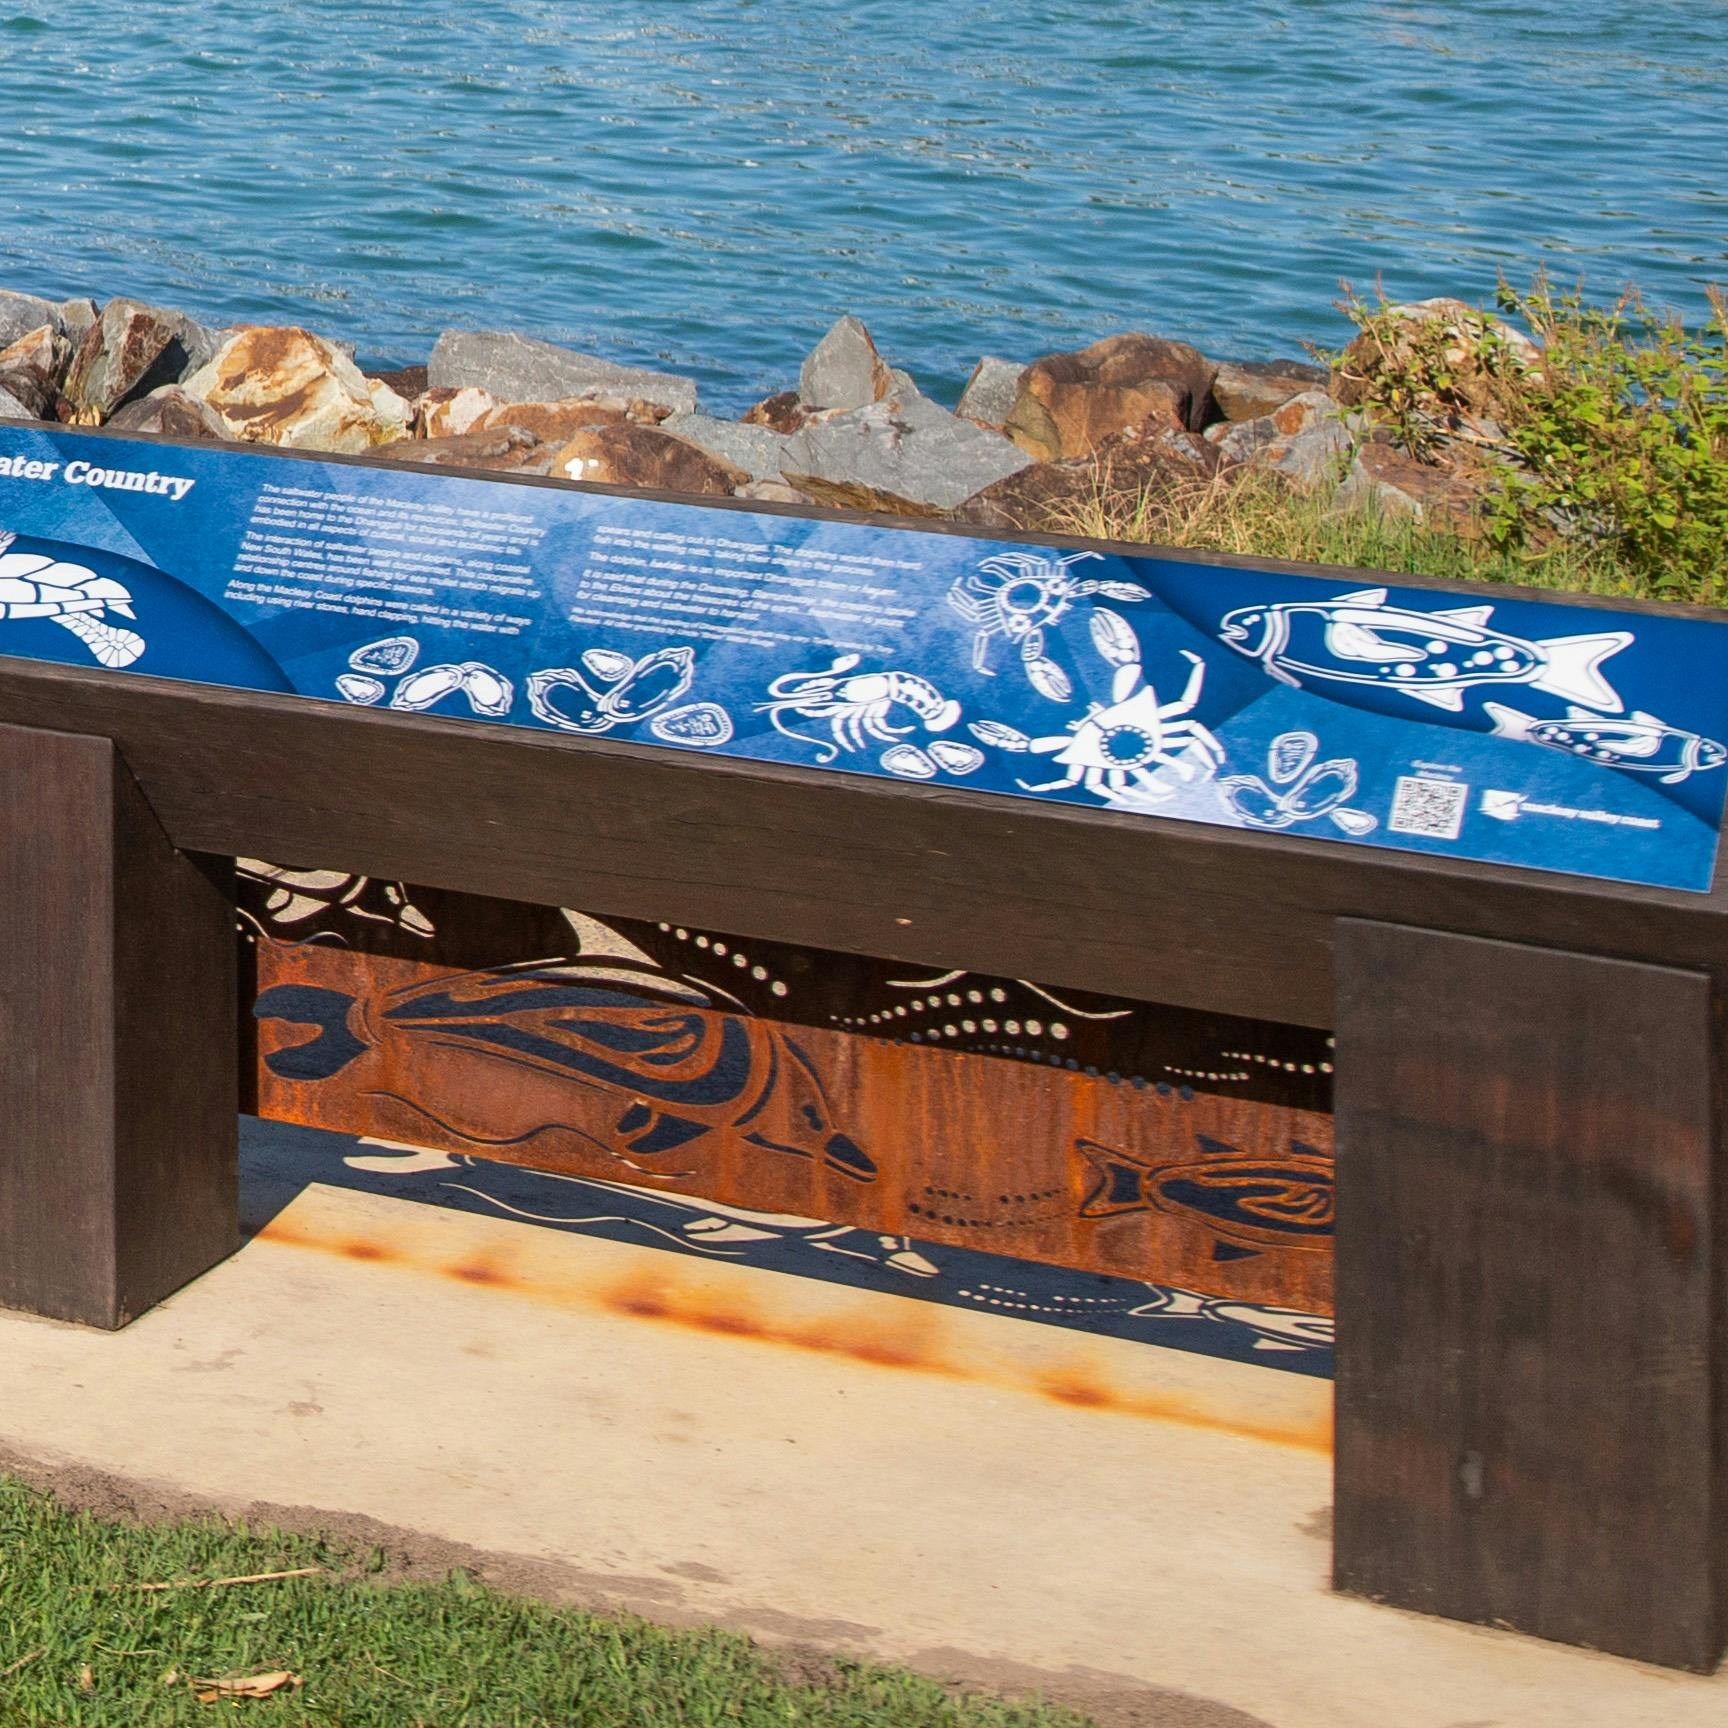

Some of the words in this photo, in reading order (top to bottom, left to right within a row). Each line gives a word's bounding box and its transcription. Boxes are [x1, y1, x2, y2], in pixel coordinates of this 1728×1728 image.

[64, 460, 195, 500] Country
[257, 495, 307, 506] connection
[309, 501, 328, 509] with
[323, 492, 356, 502] people
[272, 507, 297, 516] been
[298, 510, 325, 520] home
[241, 541, 263, 551] New
[263, 544, 291, 555] South
[344, 555, 369, 564] been
[325, 542, 366, 553] saltwater
[465, 559, 493, 570] along
[494, 563, 530, 573] coastal
[233, 563, 253, 572] and
[253, 565, 279, 575] down
[296, 572, 323, 581] coast
[324, 574, 354, 587] during
[354, 579, 391, 589] specific
[326, 565, 361, 574] around
[224, 590, 265, 604] including
[351, 606, 376, 616] hand
[228, 579, 255, 591] Along
[273, 585, 312, 598] Macleay
[313, 589, 342, 600] Coast
[343, 594, 383, 606] dolphins
[409, 603, 439, 613] called
